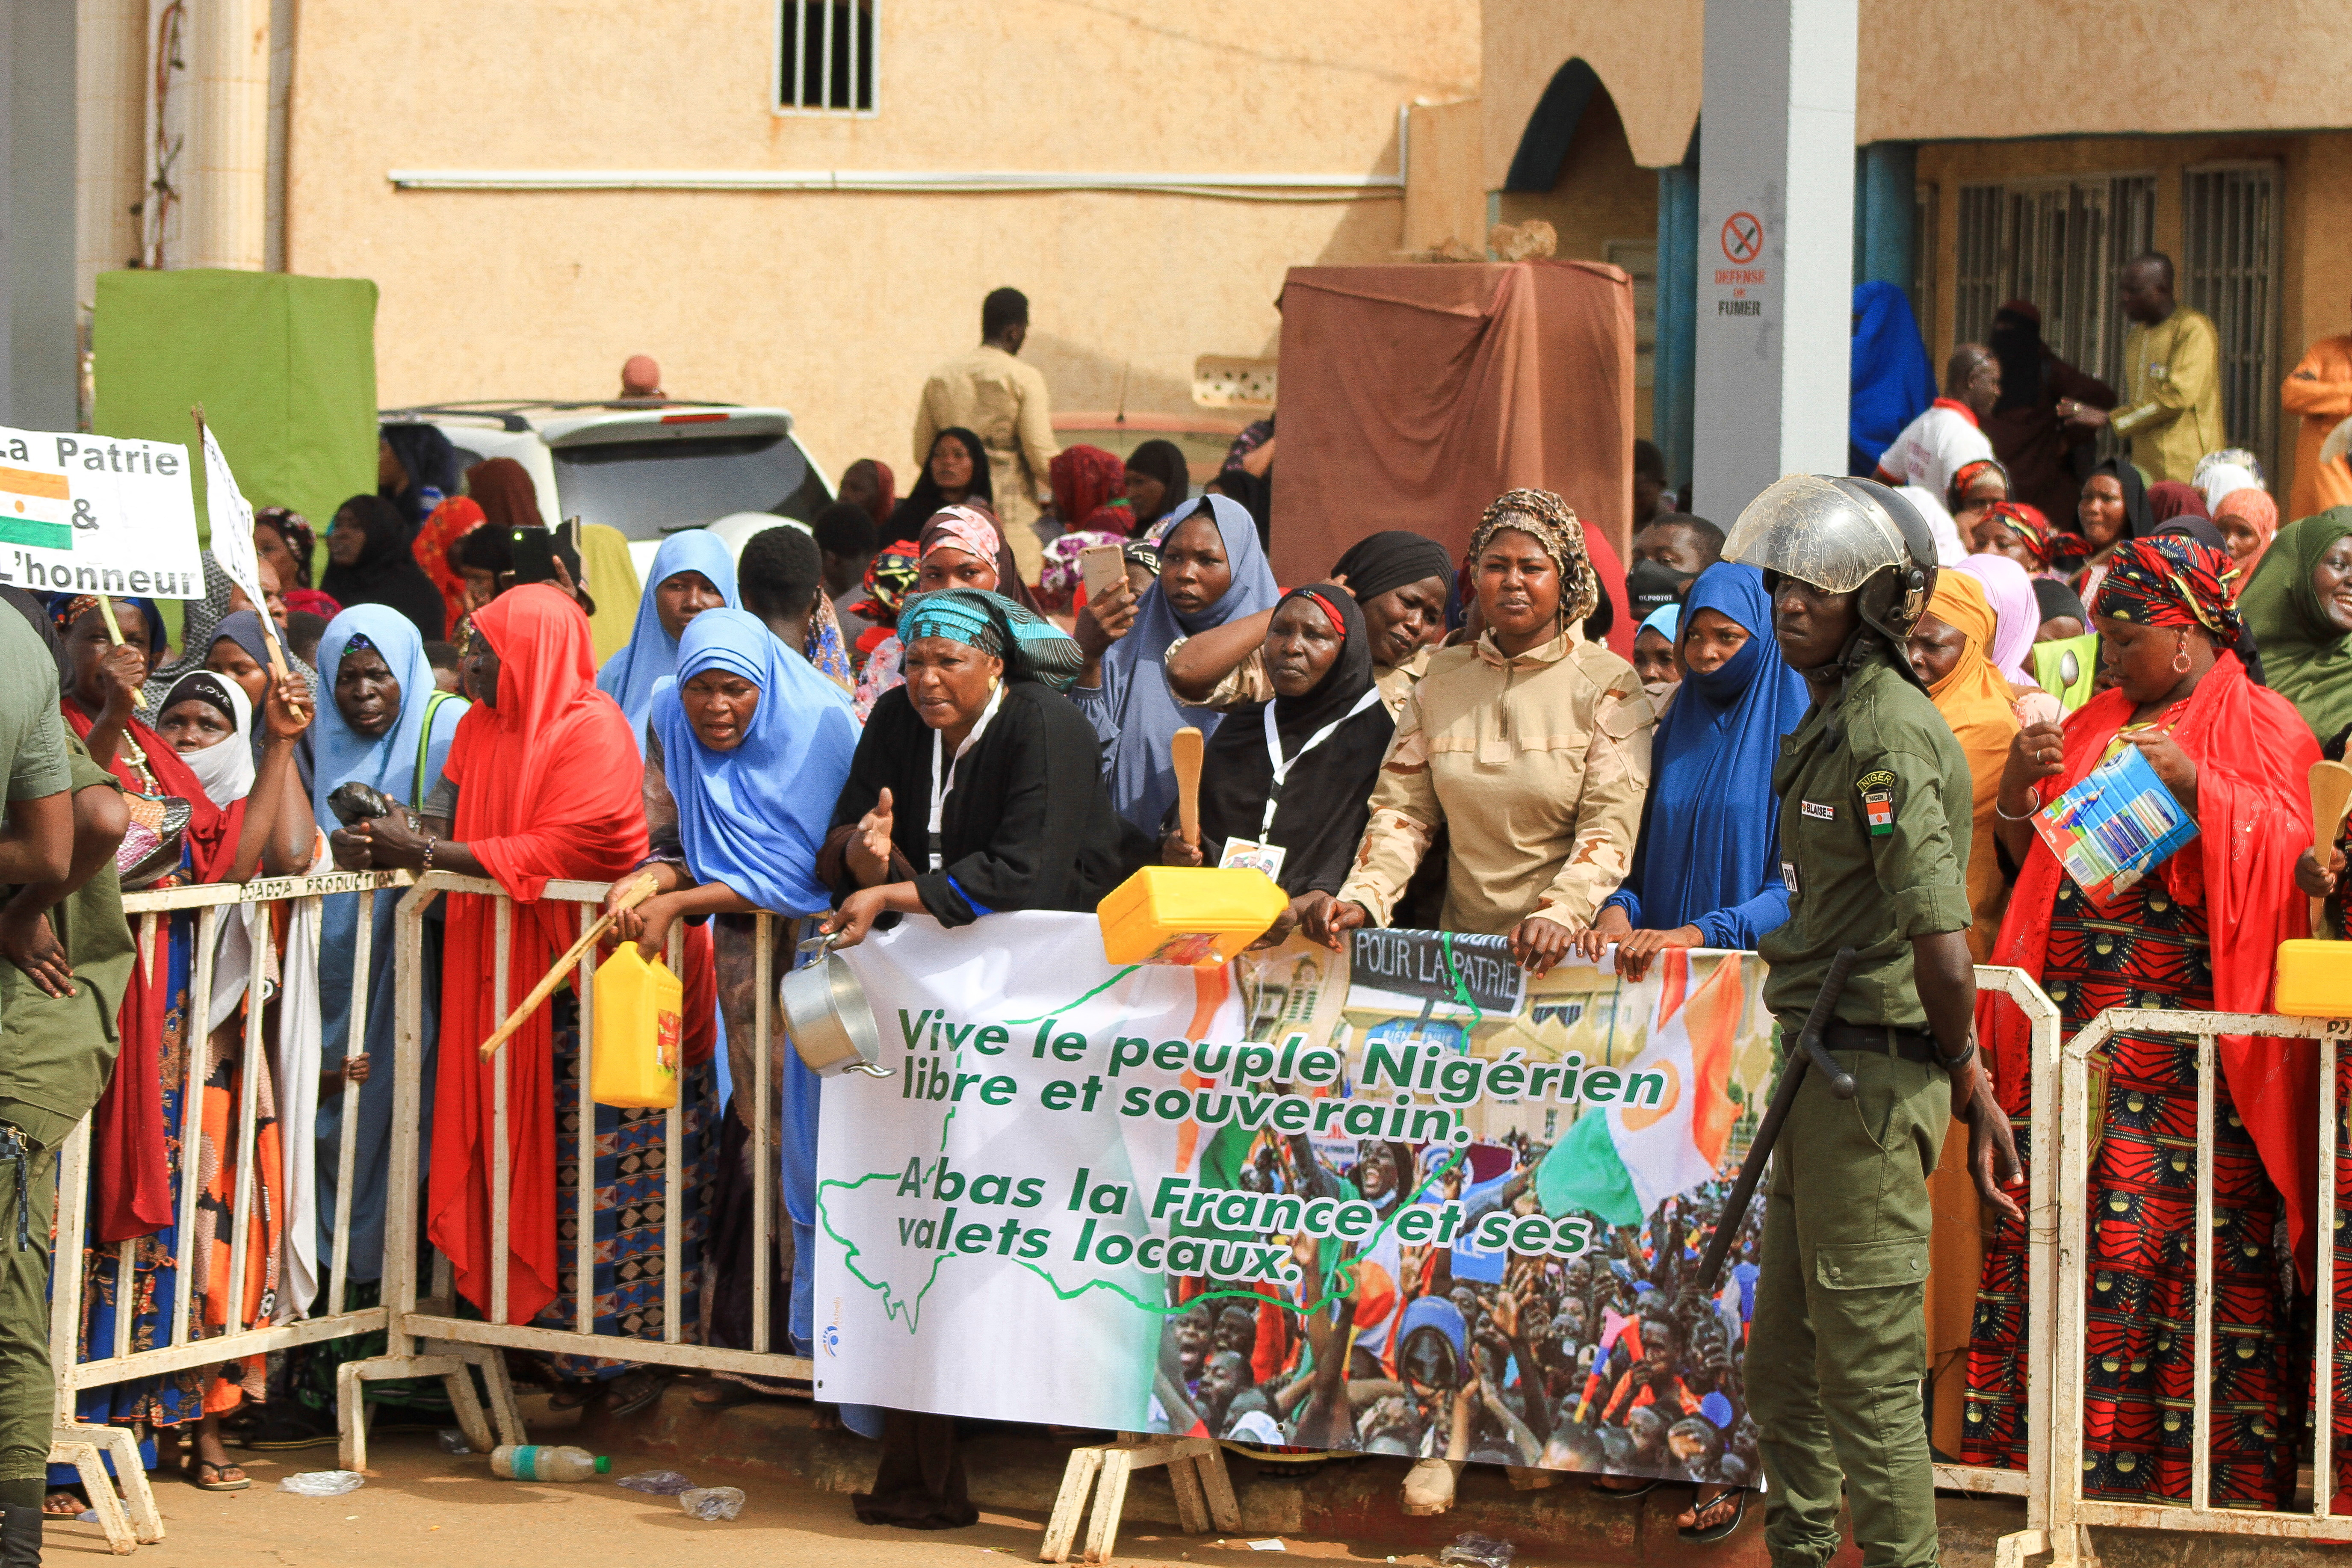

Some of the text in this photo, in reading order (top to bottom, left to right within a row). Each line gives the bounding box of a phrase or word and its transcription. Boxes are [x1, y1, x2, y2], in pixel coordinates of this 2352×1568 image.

[1715, 269, 1766, 285] DEFENSE
[1718, 301, 1761, 316] FUMER
[56, 438, 179, 475] Patrie
[72, 499, 99, 530] &
[195, 684, 230, 708] LOVE
[1862, 773, 1891, 788] NIGER
[1807, 804, 1827, 817] BLAISE
[1356, 933, 1411, 979] POUR
[897, 1009, 1664, 1104] Vive le peuple Nigérien
[902, 1055, 1468, 1143] libre et souverain.
[896, 1157, 922, 1198] A
[934, 1156, 1045, 1208] bas
[1067, 1168, 1128, 1214] la
[1151, 1177, 1373, 1237] France
[1396, 1205, 1461, 1242] et
[1477, 1217, 1589, 1256] ses
[897, 1208, 1298, 1280] valets locaux.
